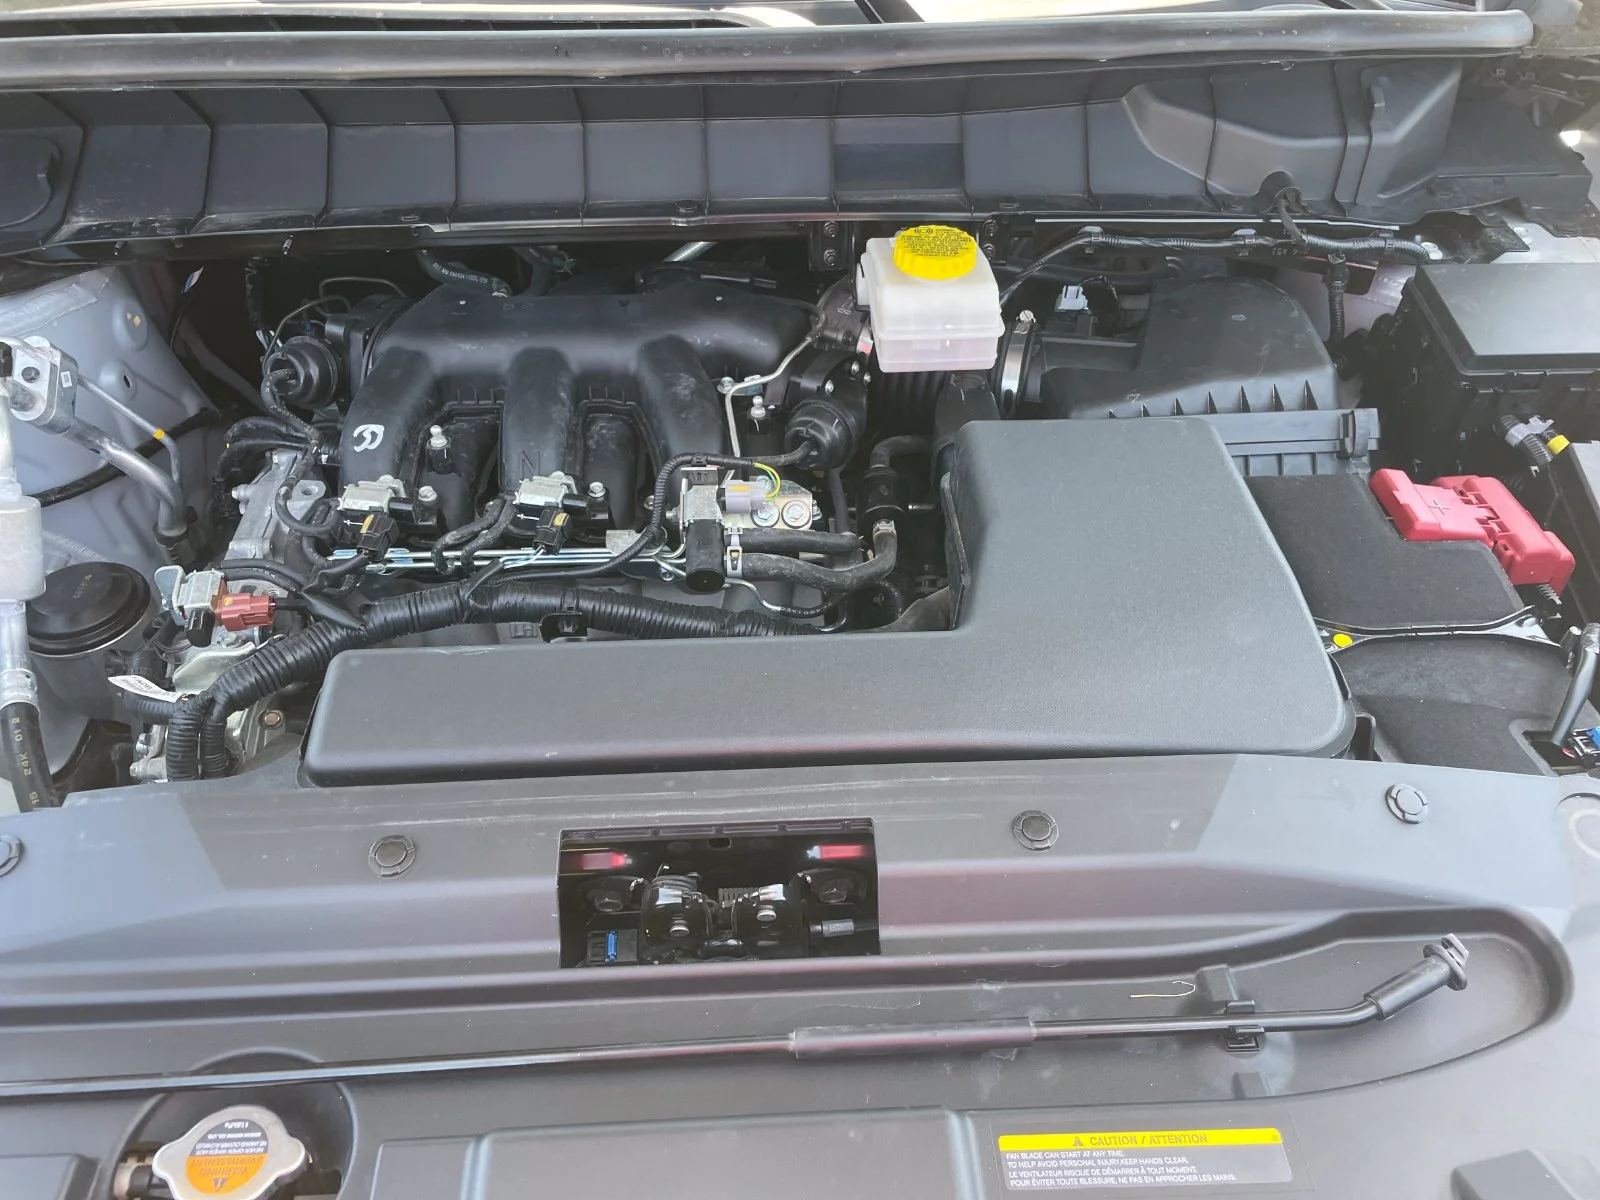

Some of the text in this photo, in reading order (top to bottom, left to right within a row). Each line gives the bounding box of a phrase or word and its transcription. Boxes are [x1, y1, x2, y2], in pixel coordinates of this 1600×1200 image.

[1089, 1135, 1137, 1146] CAUTION
[1149, 1134, 1207, 1145] ATTENTION
[1006, 1152, 1020, 1160] FAN
[1044, 1151, 1060, 1159] CAN
[1082, 1150, 1091, 1158] AT
[1007, 1161, 1018, 1169] TO
[1018, 1160, 1036, 1168] HELP
[1037, 1160, 1059, 1168] AVOID
[1059, 1159, 1096, 1167] PERSONAL
[1139, 1157, 1164, 1165] HANDS
[200, 1166, 248, 1177] WARNING
[1018, 1170, 1063, 1178] VENTILATEUR
[1091, 1168, 1101, 1176] DE
[1010, 1179, 1031, 1187] POUR
